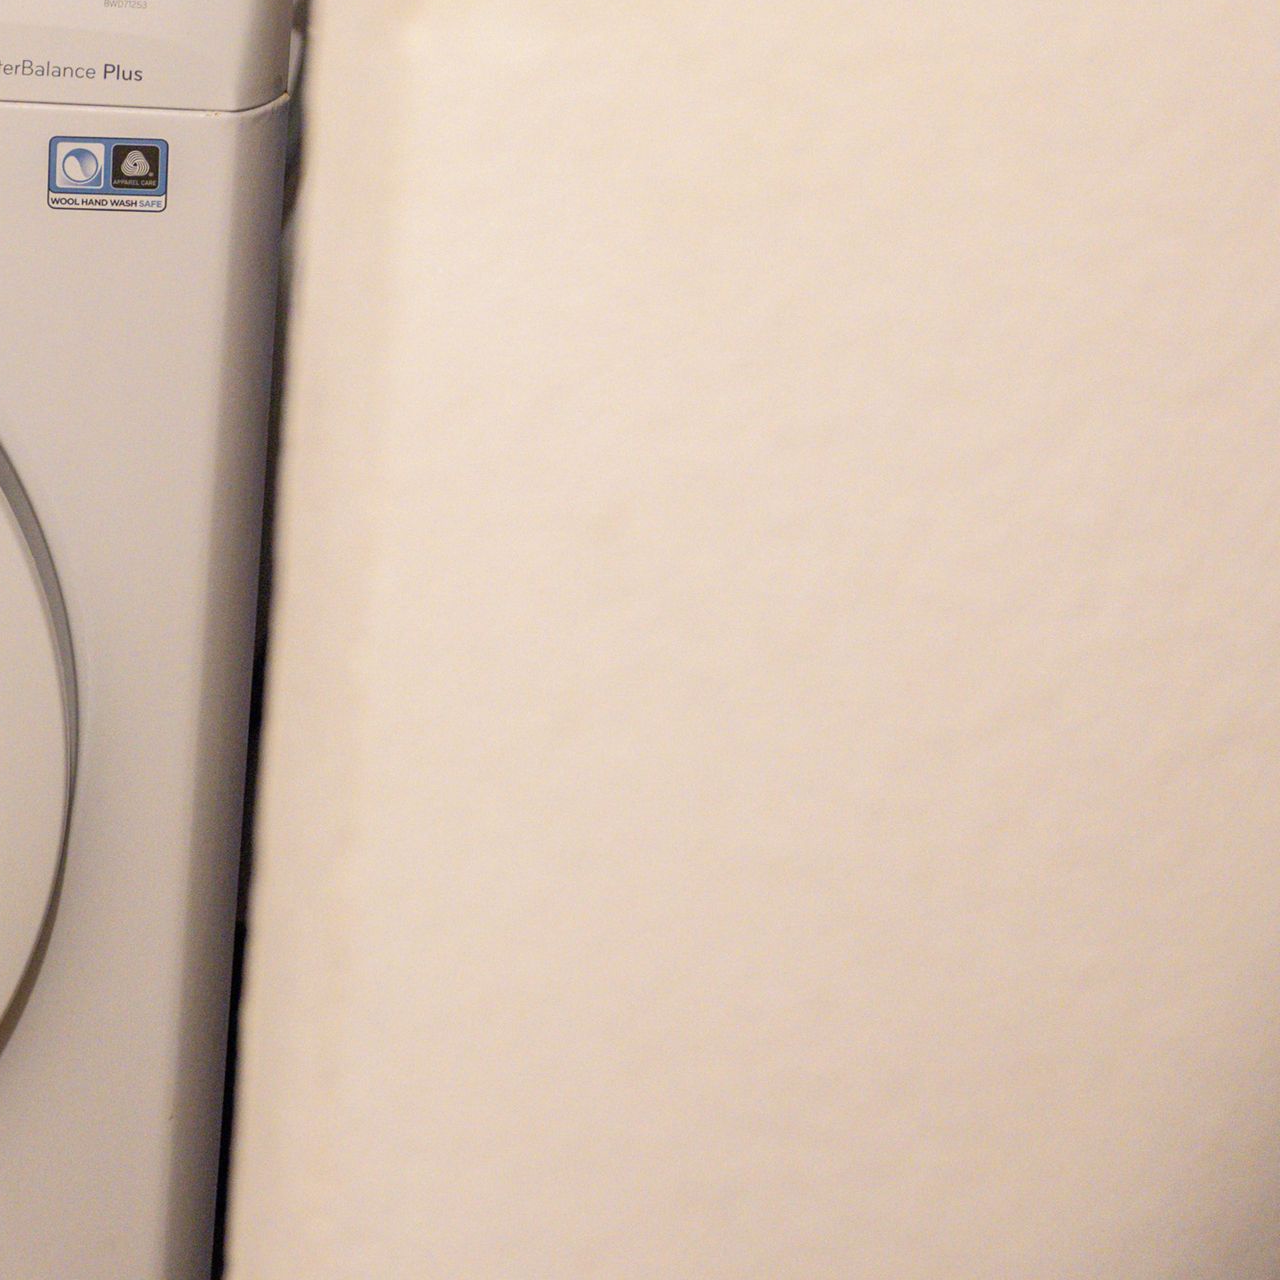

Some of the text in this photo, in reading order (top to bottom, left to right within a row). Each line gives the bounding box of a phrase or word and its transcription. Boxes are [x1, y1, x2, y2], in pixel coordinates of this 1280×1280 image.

[103, 63, 143, 82] Plus
[50, 197, 162, 208] WOOL HAND WASH SAFE
